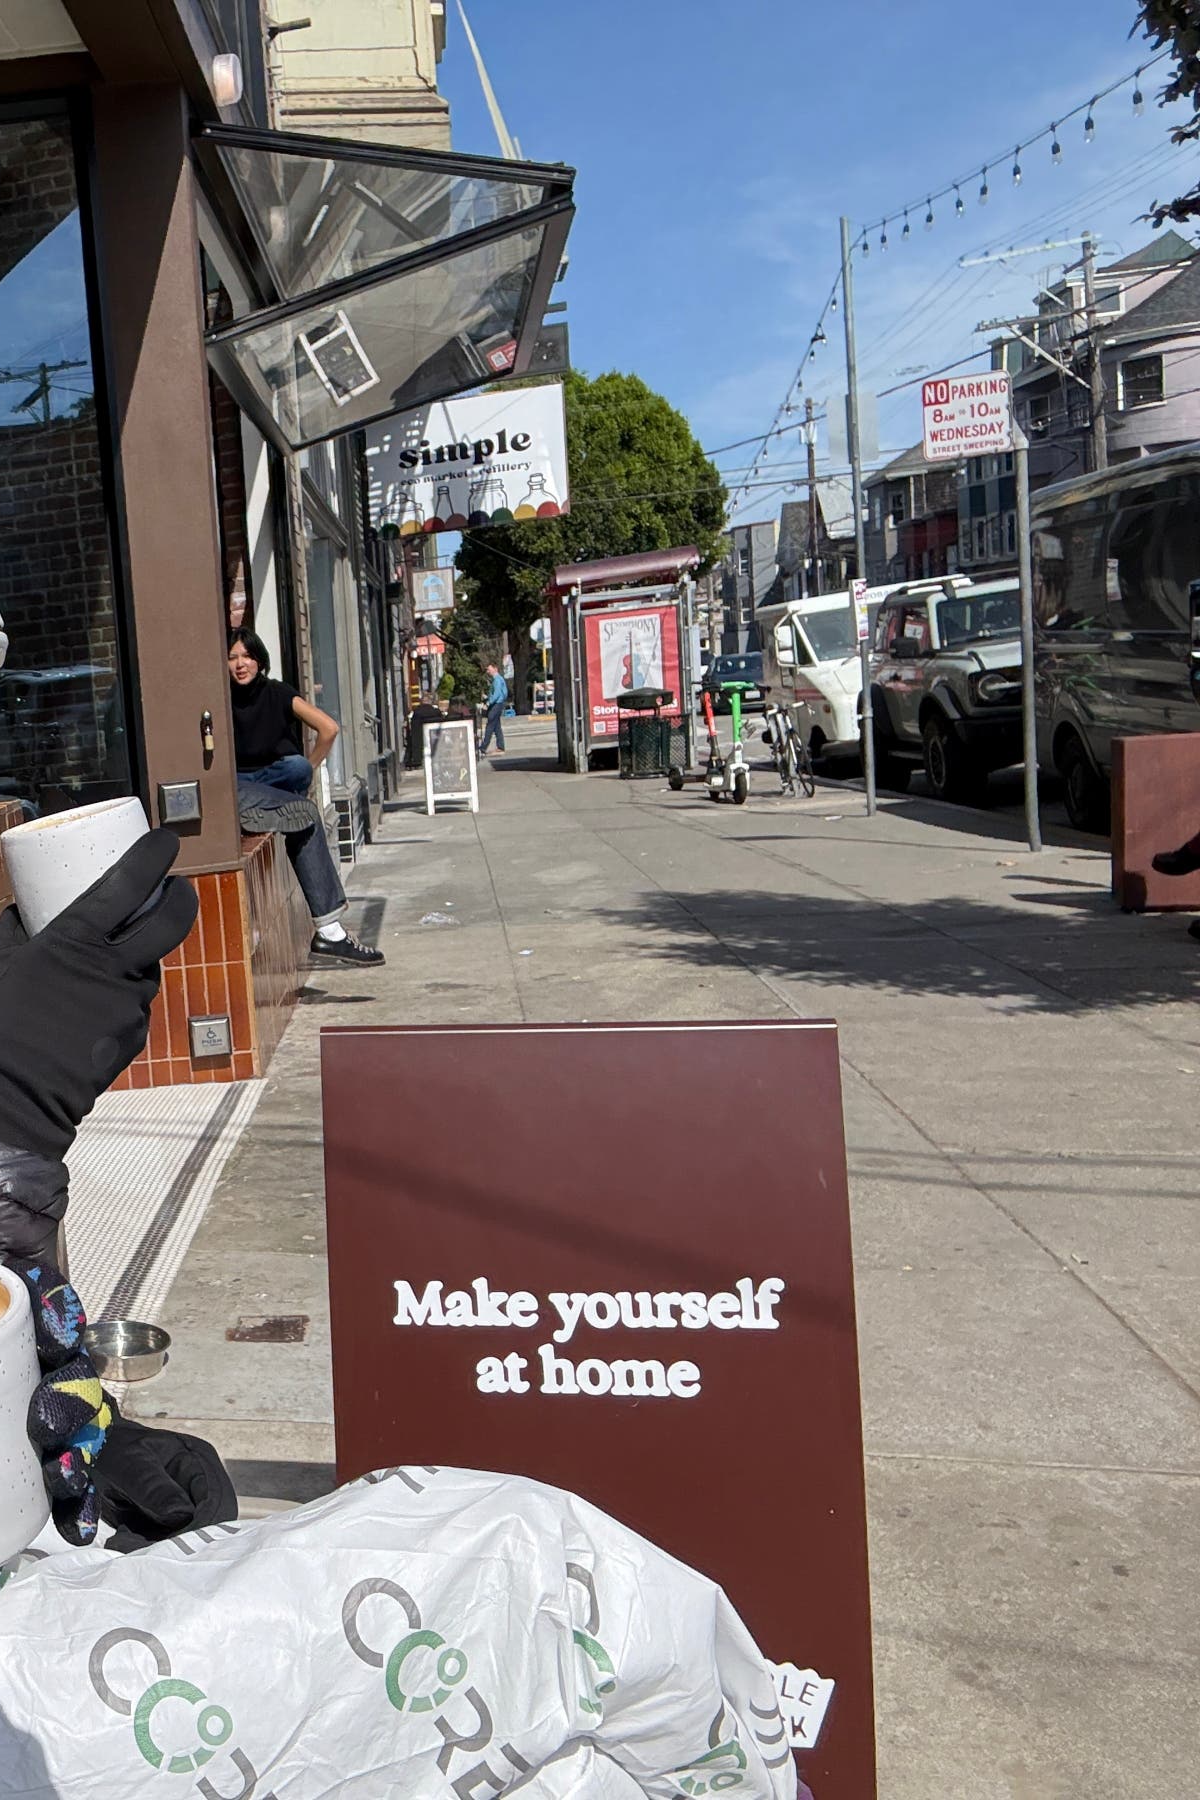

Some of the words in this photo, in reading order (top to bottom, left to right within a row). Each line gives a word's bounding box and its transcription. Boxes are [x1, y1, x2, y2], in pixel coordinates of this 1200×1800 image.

[923, 382, 948, 405] NO
[951, 378, 1008, 401] PARKING
[929, 420, 1005, 443] WEDNESDAY
[932, 443, 961, 455] STREET
[963, 438, 1005, 451] SWEEPING
[398, 427, 532, 469] simple
[423, 468, 469, 483] market
[479, 460, 533, 476] refillery
[393, 1276, 539, 1328] Make
[548, 1277, 785, 1343] yourself
[476, 1351, 530, 1393] at
[537, 1343, 701, 1398] home
[771, 1673, 819, 1707] LE
